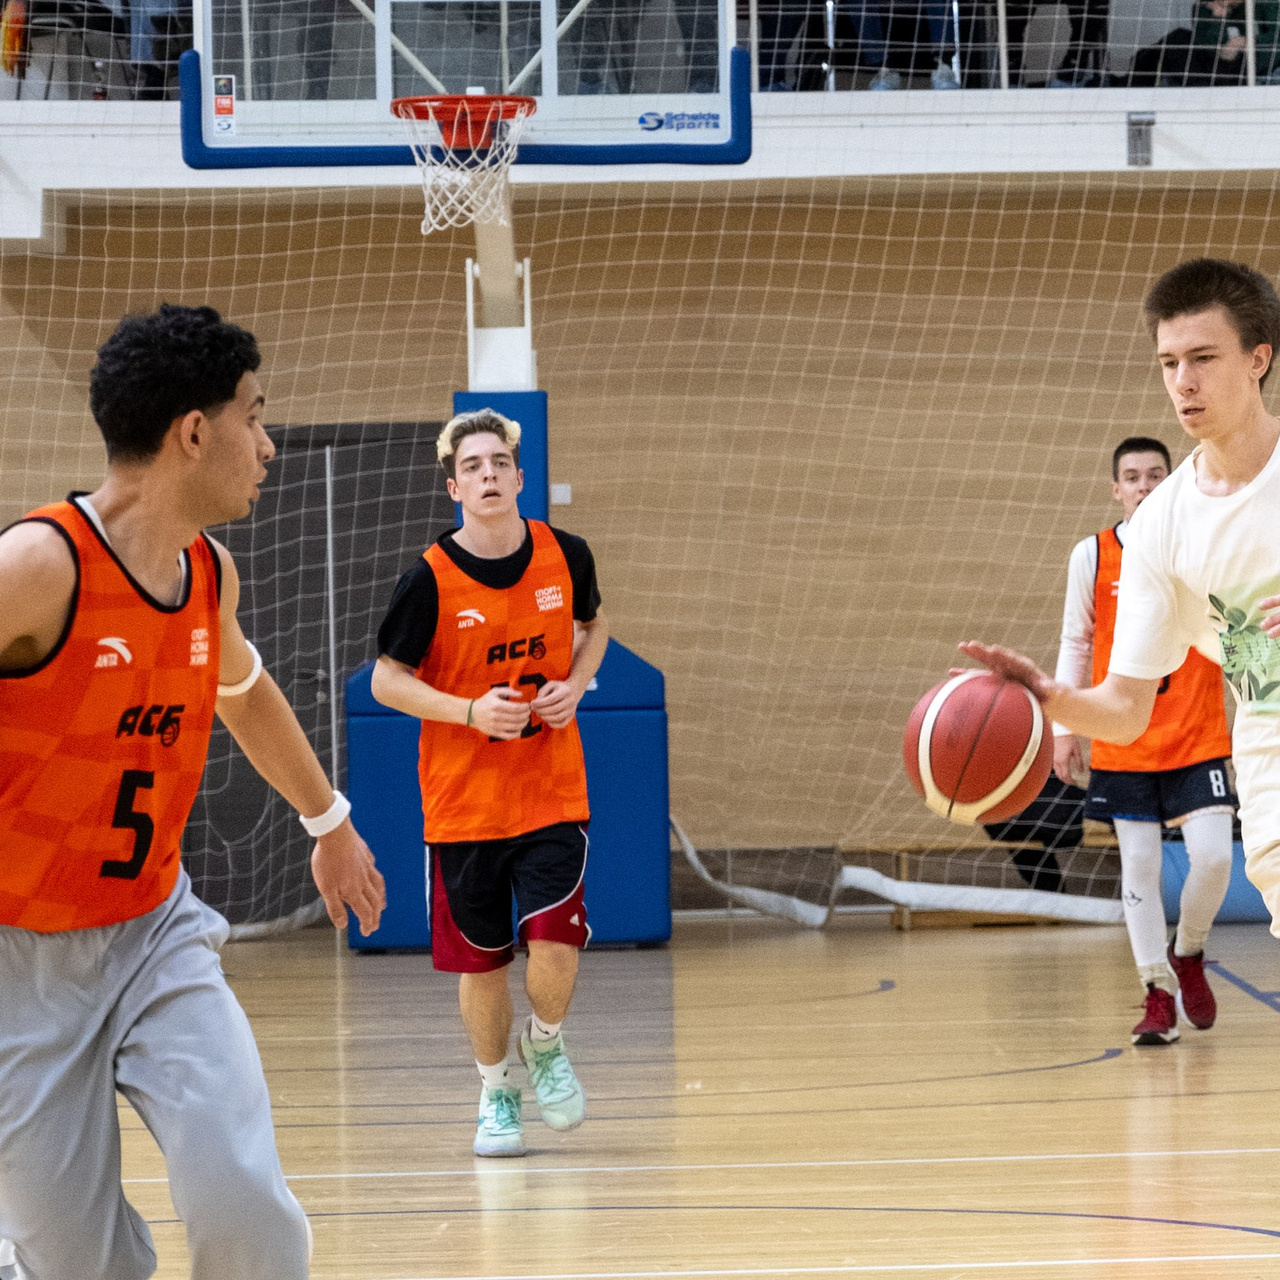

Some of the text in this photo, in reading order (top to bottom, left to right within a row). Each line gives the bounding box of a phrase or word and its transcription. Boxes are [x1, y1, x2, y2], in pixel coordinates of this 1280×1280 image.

[665, 121, 720, 131] Sports
[1209, 769, 1226, 797] 8
[99, 770, 154, 880] 5
